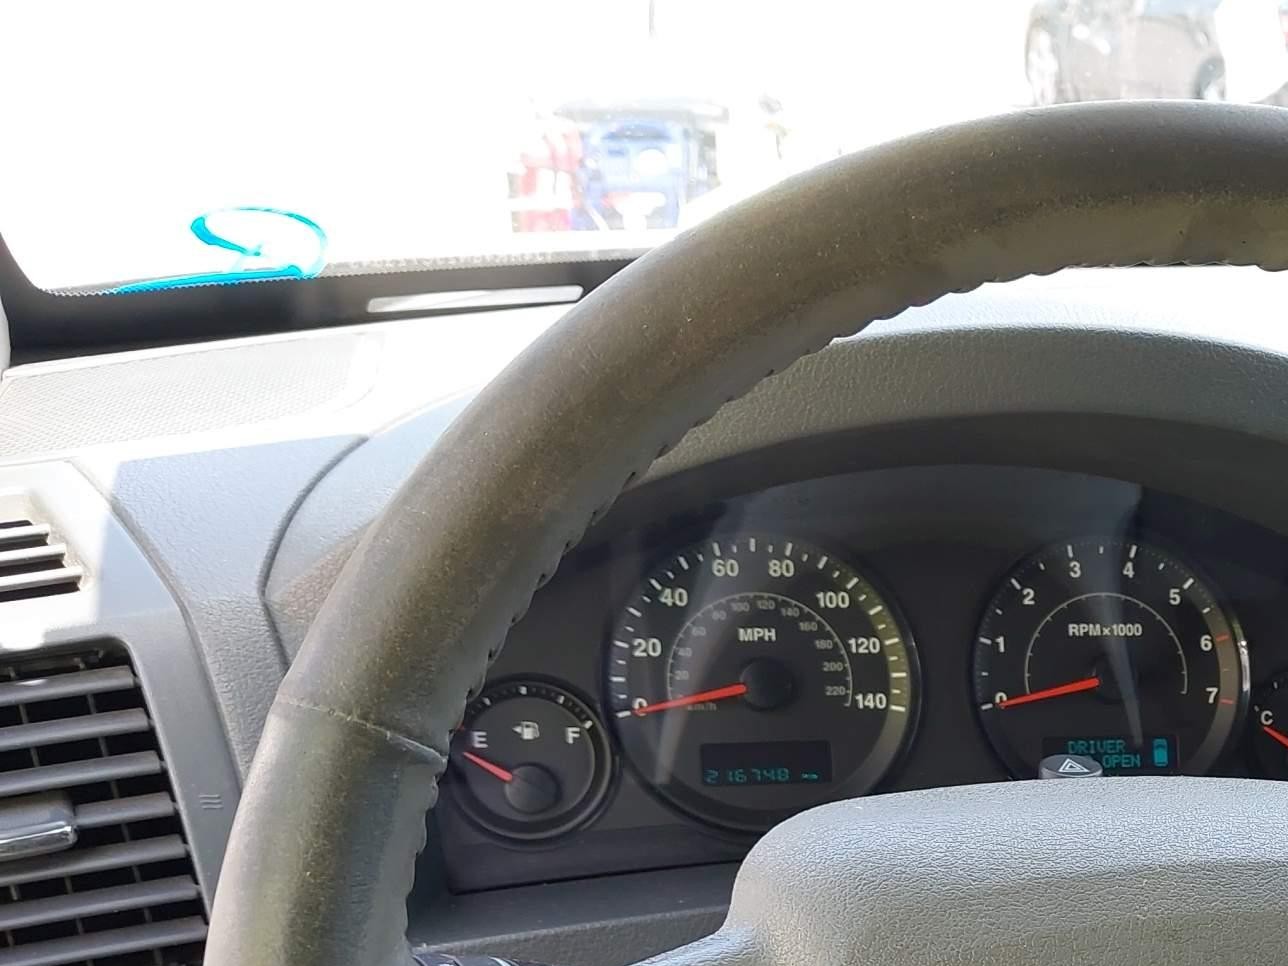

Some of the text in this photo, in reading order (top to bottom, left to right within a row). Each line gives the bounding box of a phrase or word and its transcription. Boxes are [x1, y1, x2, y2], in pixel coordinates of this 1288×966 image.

[712, 559, 739, 577] 60
[768, 559, 795, 577] 80
[1070, 561, 1081, 578] 3
[1123, 560, 1135, 578] 4
[659, 588, 689, 607] 40
[816, 591, 850, 609] 100
[1022, 588, 1035, 605] 2
[1169, 588, 1181, 605] 5
[738, 628, 776, 642] MPH
[1200, 635, 1212, 651] 6
[633, 638, 662, 657] 20
[848, 637, 881, 654] 120
[996, 636, 1005, 653] 1
[855, 693, 887, 710] 140
[1206, 687, 1218, 703] 7
[1260, 710, 1274, 726] C
[472, 731, 488, 748] E
[566, 727, 580, 744] F
[1068, 739, 1126, 754] DRIVER
[1102, 753, 1141, 768] OPEN
